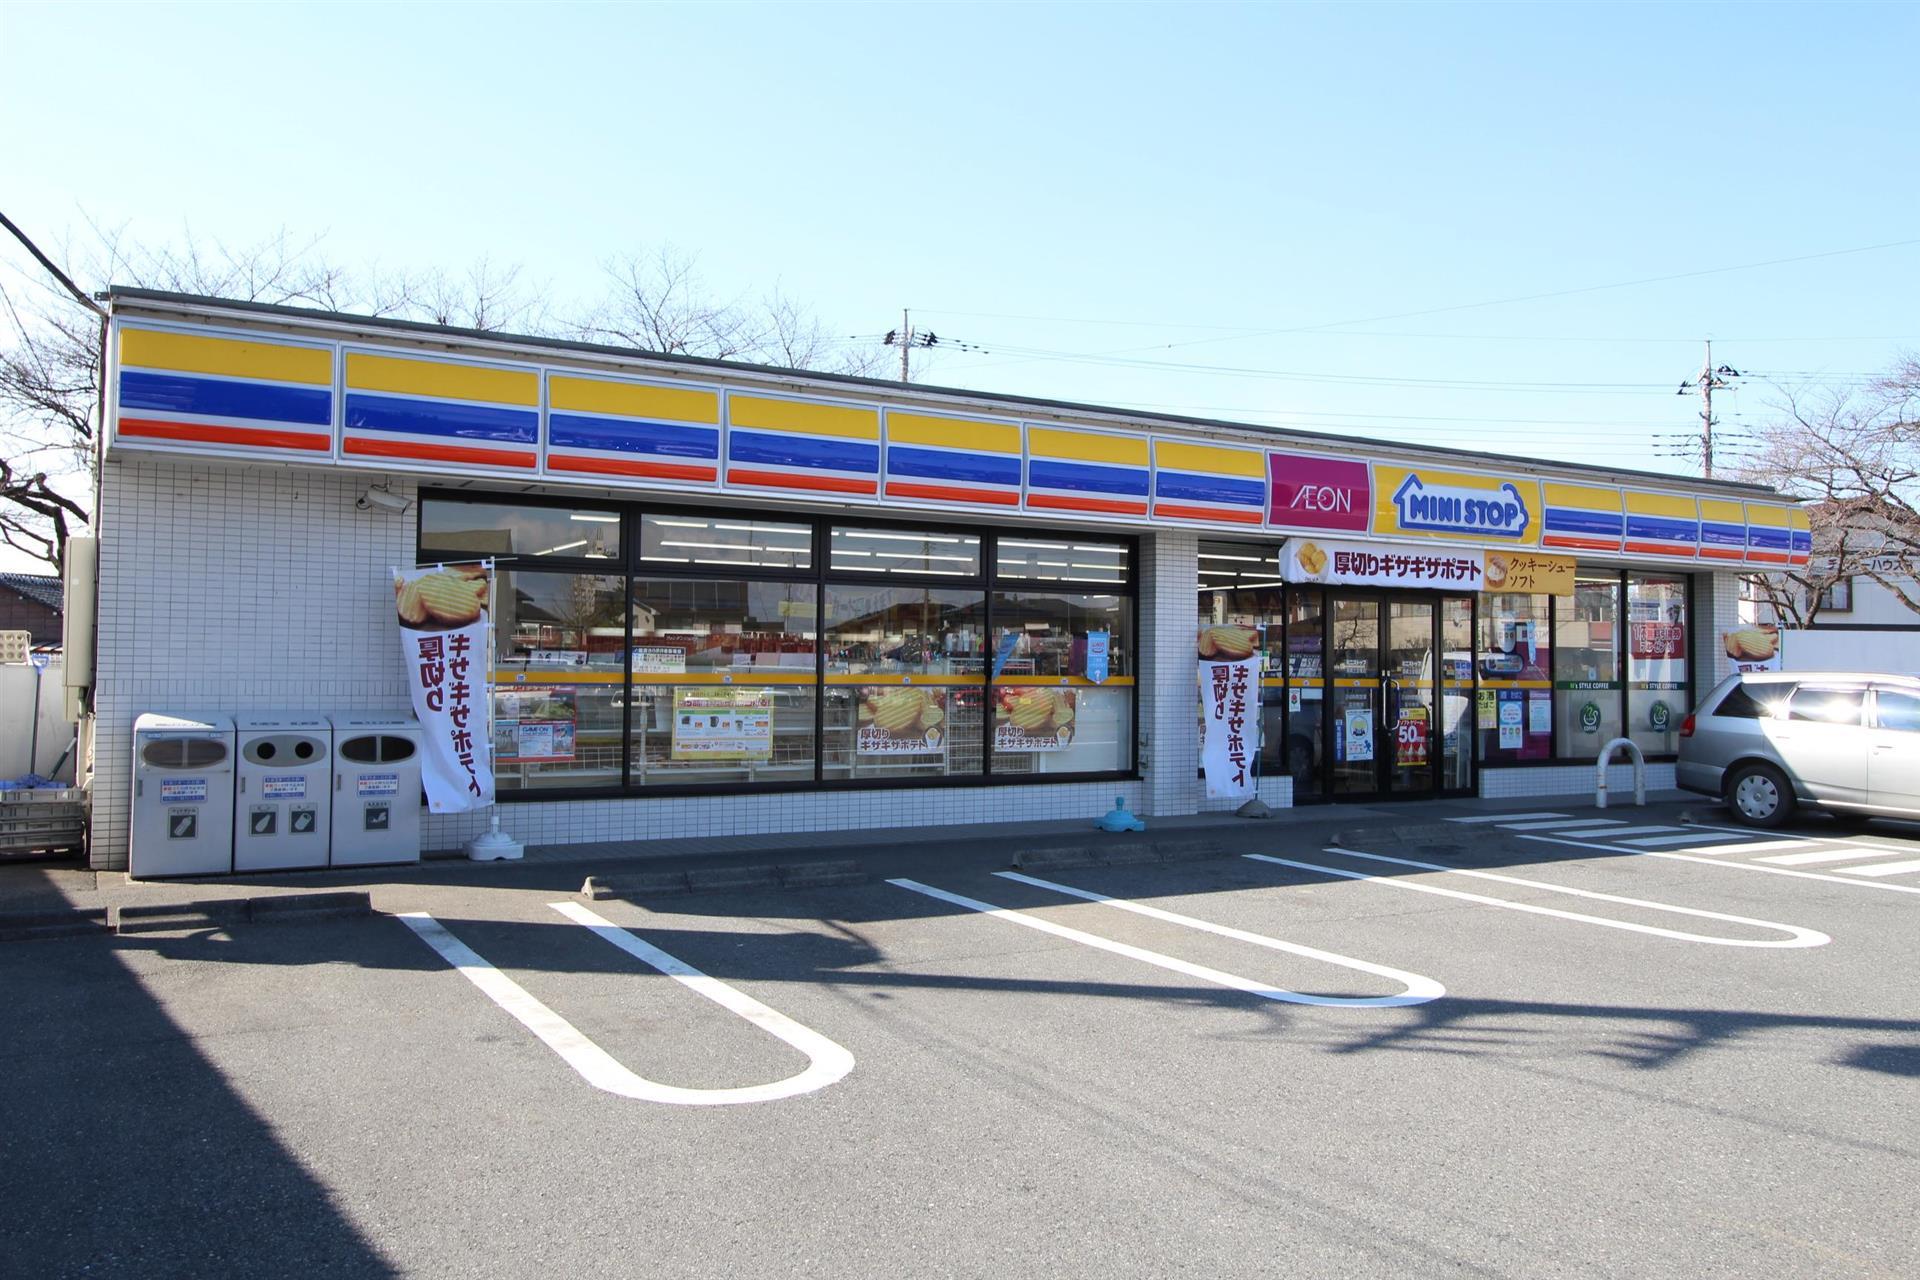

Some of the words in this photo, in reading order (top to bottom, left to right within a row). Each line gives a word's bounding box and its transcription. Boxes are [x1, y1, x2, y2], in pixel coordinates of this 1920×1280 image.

[1410, 494, 1461, 522] MINI
[1464, 498, 1519, 527] STOP
[1334, 550, 1482, 582] 厚切りギザギザポテト
[1509, 557, 1576, 576] クッキーシュー
[1509, 575, 1536, 589] ソフト
[860, 728, 890, 740] 厚切り
[998, 726, 1025, 738] 厚切り
